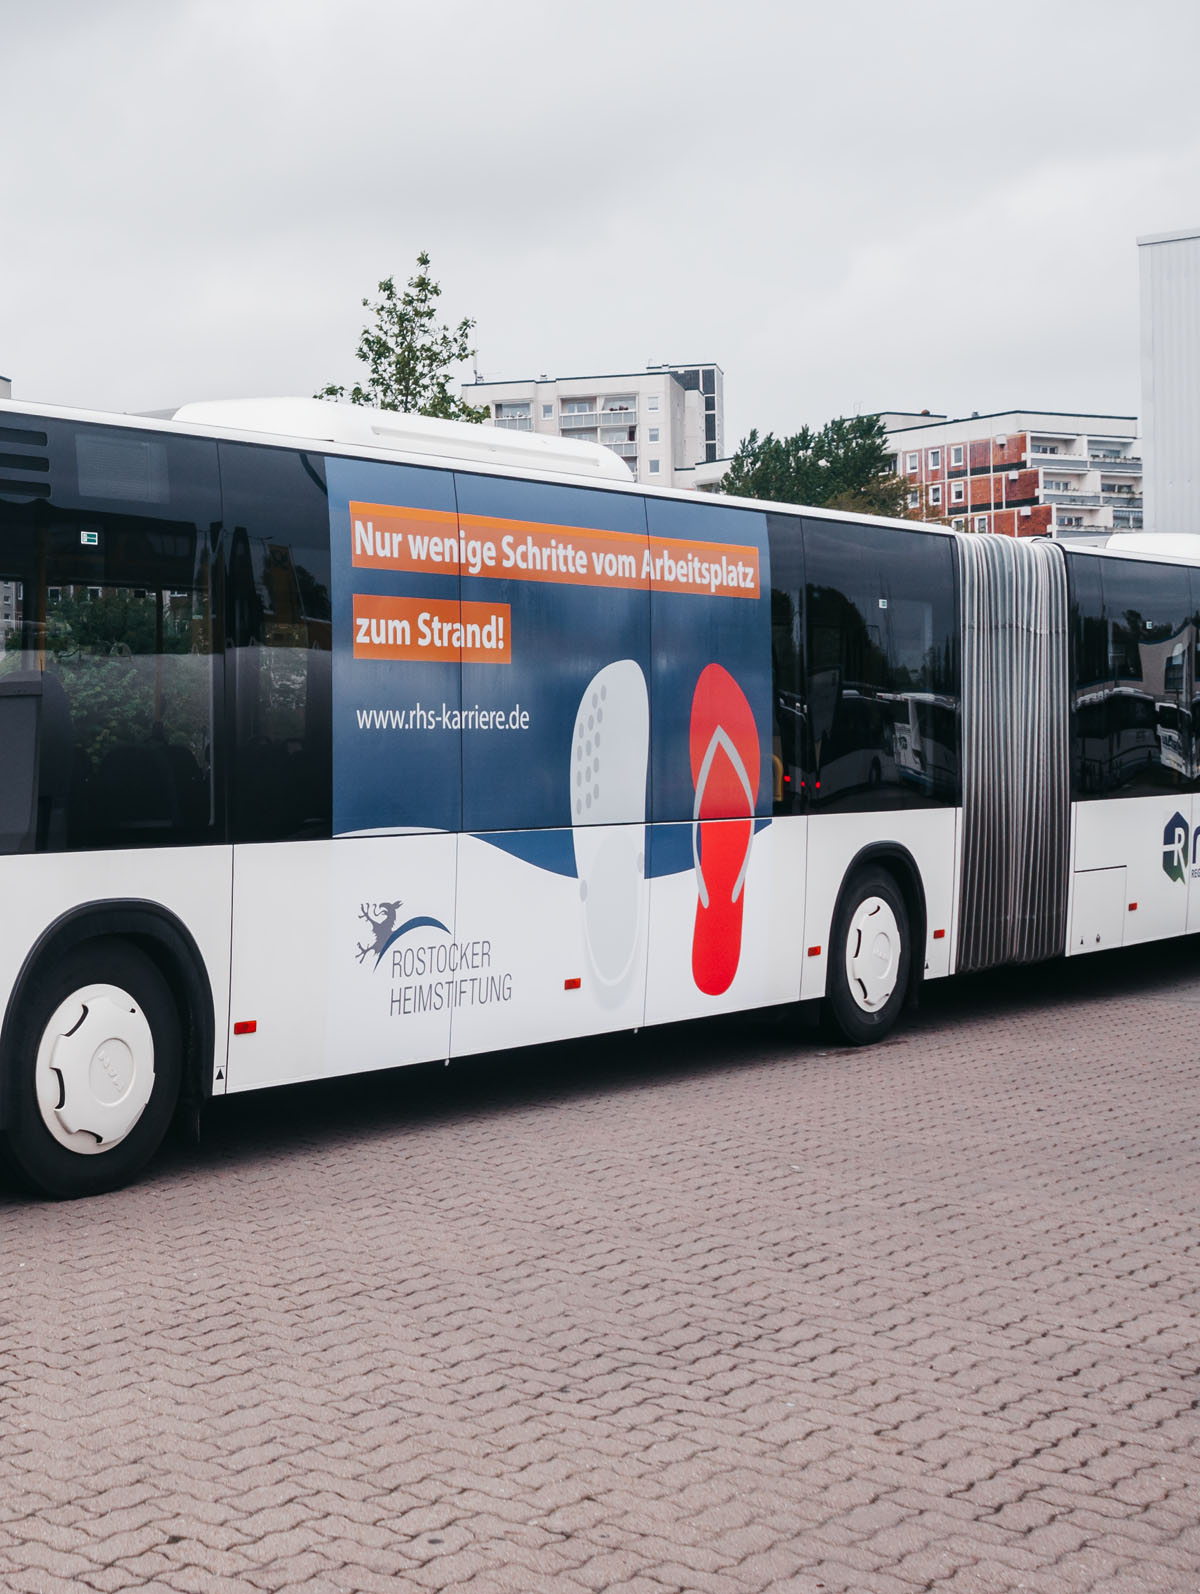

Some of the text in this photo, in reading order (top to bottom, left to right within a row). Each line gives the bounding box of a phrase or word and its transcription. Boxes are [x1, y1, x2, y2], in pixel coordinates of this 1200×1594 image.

[354, 519, 755, 592] Nur wenige Schritte vom Arbeitsplatz
[356, 612, 504, 650] zum Strand!
[356, 702, 530, 730] www.rhs-karriere.de
[391, 940, 492, 979] ROSTOCKER
[390, 973, 513, 1017] HEIMSTIFTUNG
